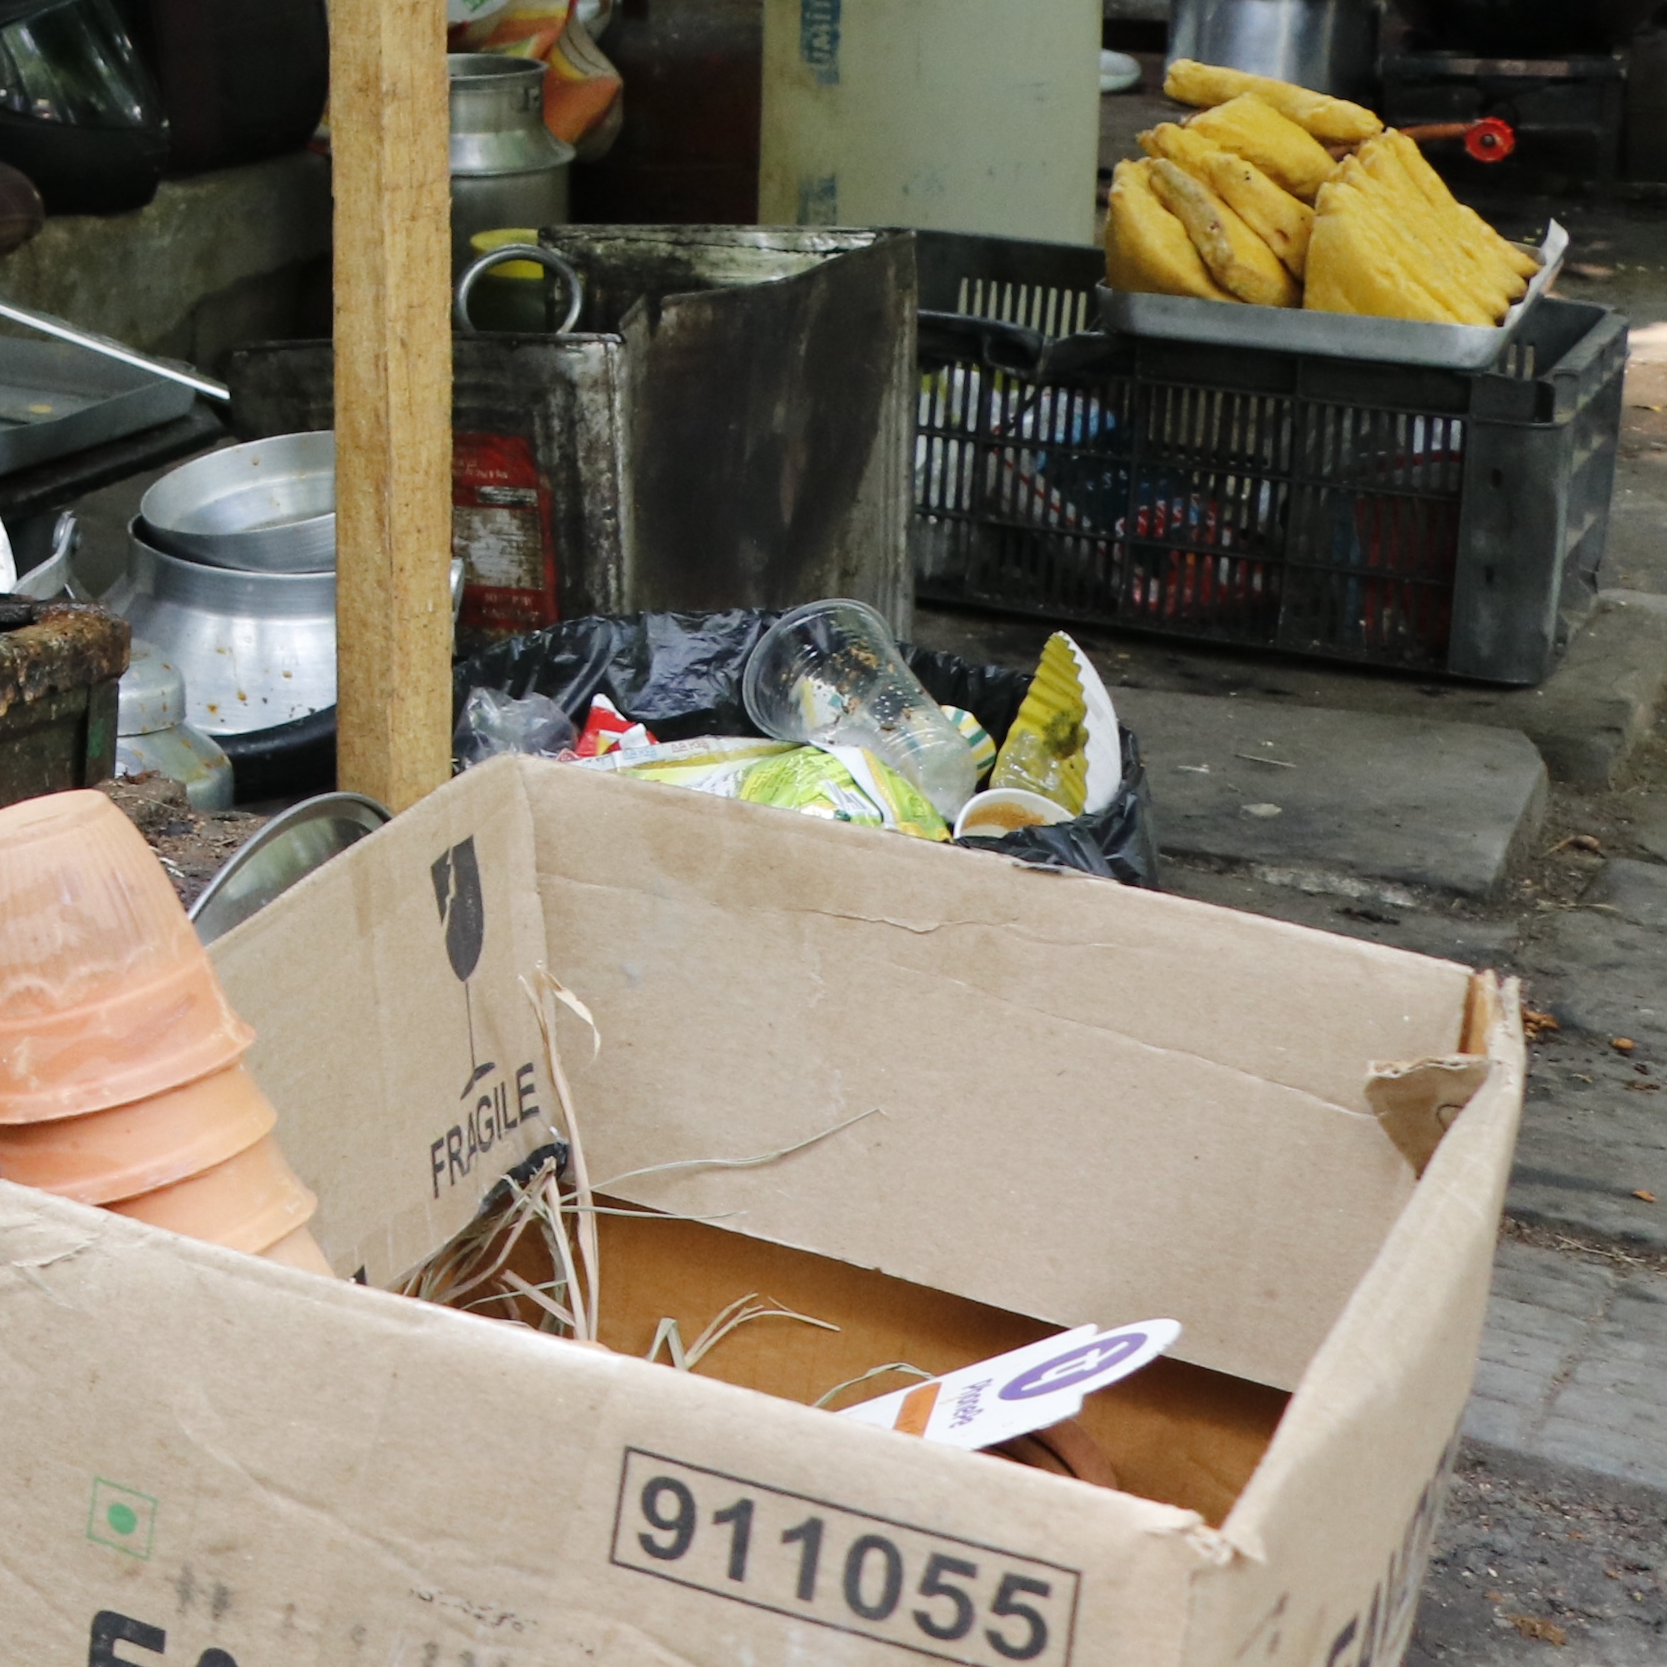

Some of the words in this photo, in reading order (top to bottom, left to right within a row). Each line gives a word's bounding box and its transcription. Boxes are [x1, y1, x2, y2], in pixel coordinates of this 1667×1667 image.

[430, 1062, 540, 1200] FRAGILE
[948, 1378, 995, 1430] PhonePe
[638, 1475, 1056, 1664] 911055
